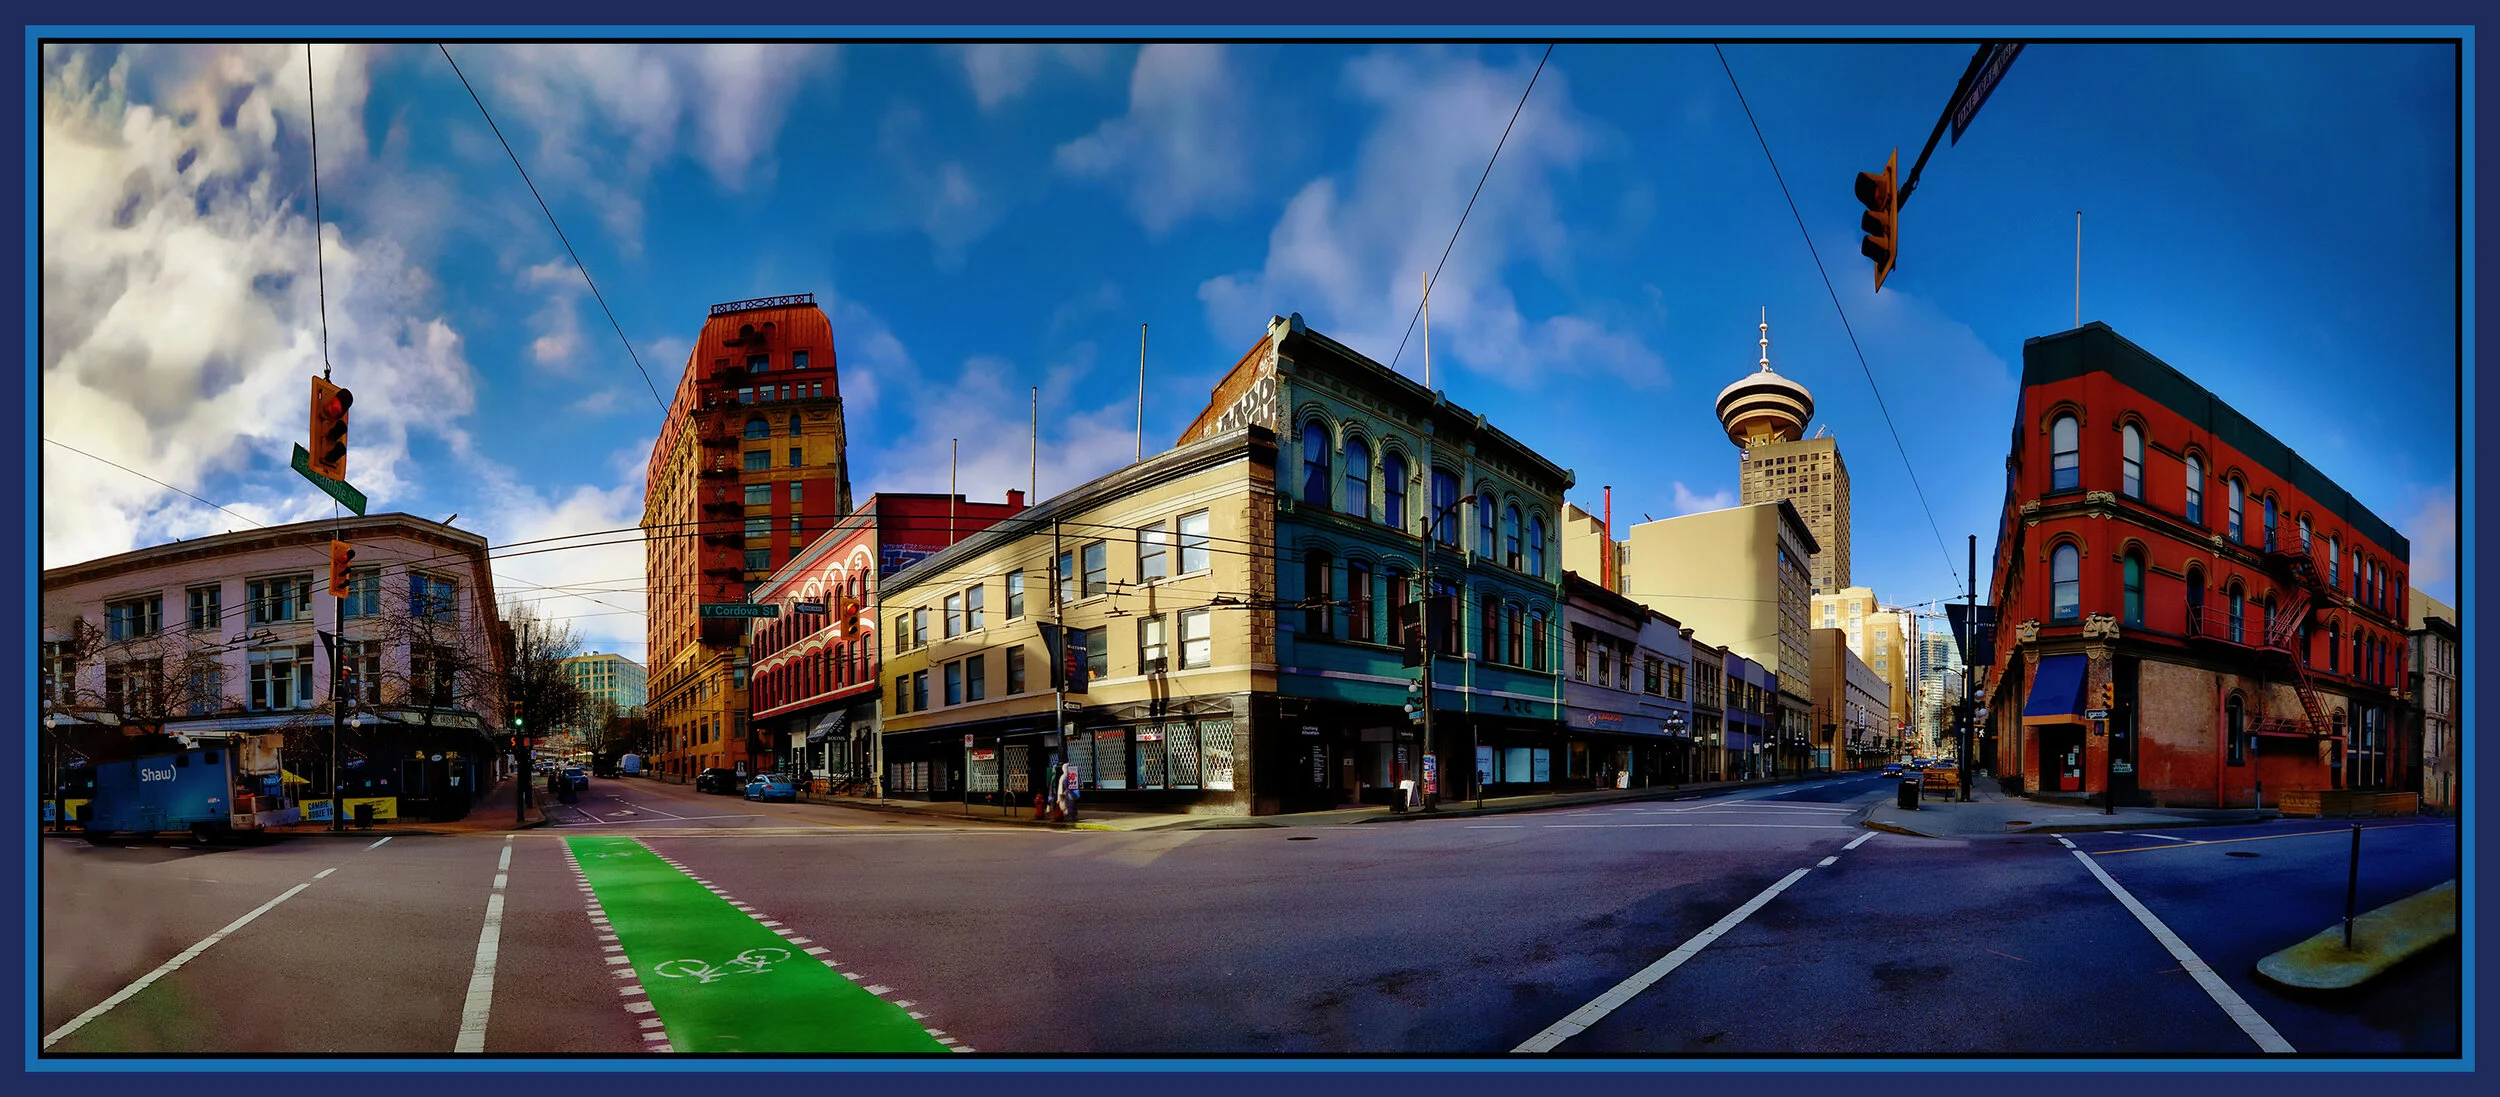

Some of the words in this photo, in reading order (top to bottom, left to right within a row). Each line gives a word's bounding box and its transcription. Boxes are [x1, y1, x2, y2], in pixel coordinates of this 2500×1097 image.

[315, 474, 346, 498] Cambie
[715, 606, 758, 615] Cordova
[763, 606, 774, 615] St
[308, 801, 329, 810] CAMBIE
